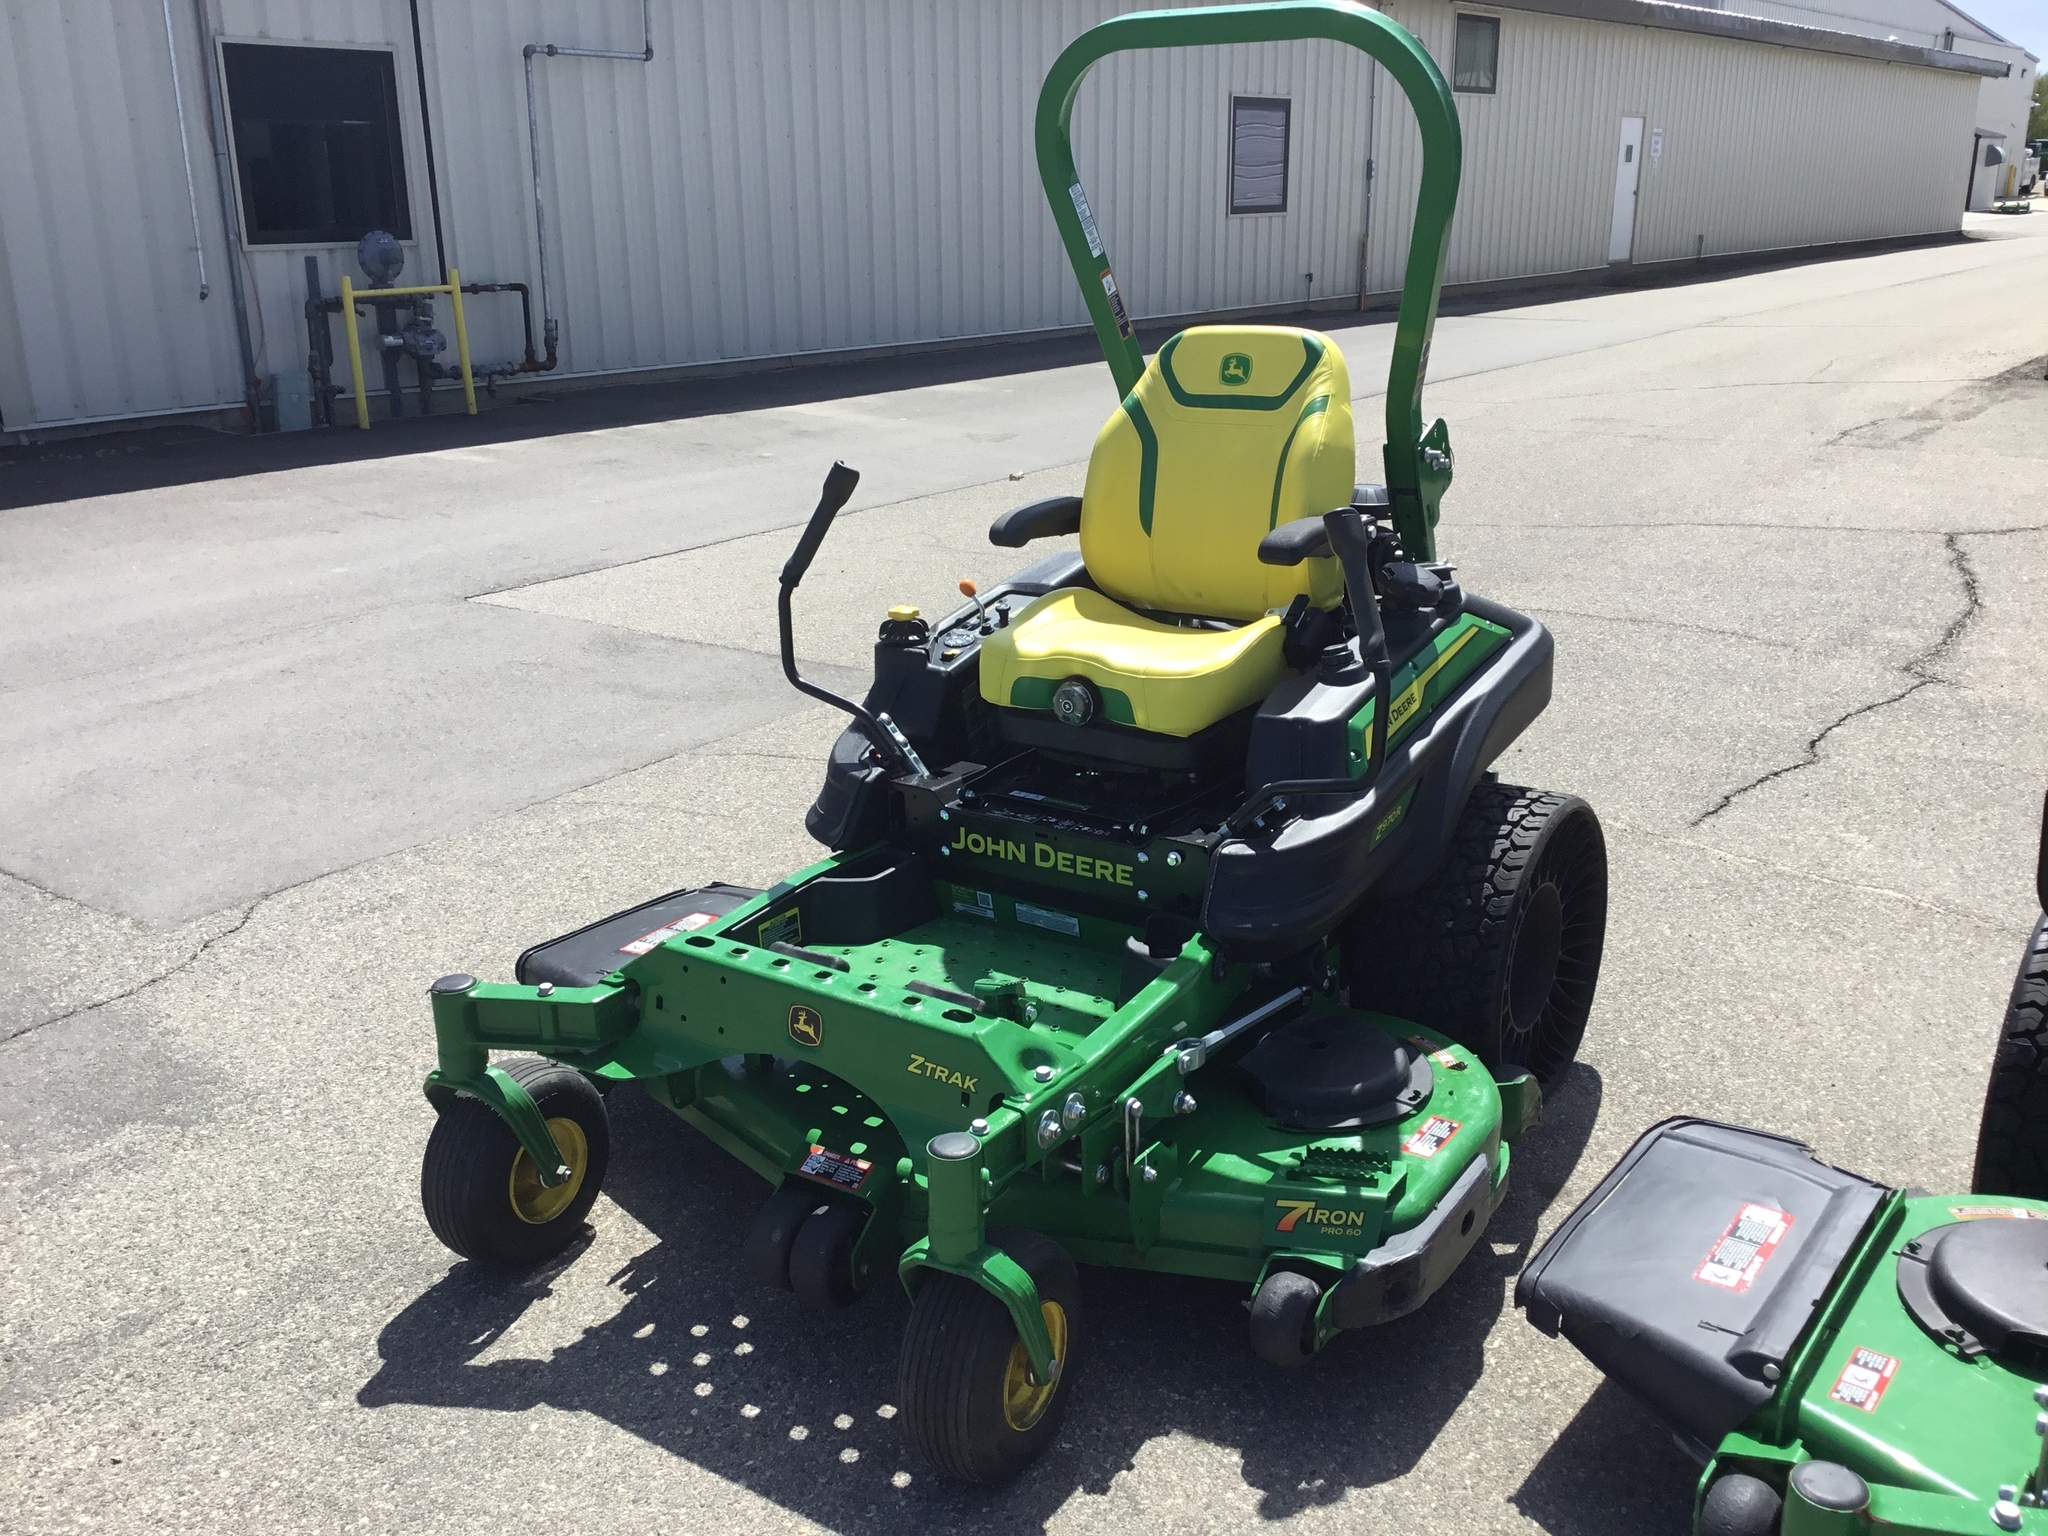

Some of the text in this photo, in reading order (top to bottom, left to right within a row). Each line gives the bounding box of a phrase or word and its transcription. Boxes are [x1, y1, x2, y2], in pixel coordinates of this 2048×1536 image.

[1390, 692, 1417, 722] DEERE
[951, 826, 1134, 886] JOHN DEERE
[907, 1053, 979, 1093] ZTRAK
[1320, 1227, 1362, 1236] PRO 60
